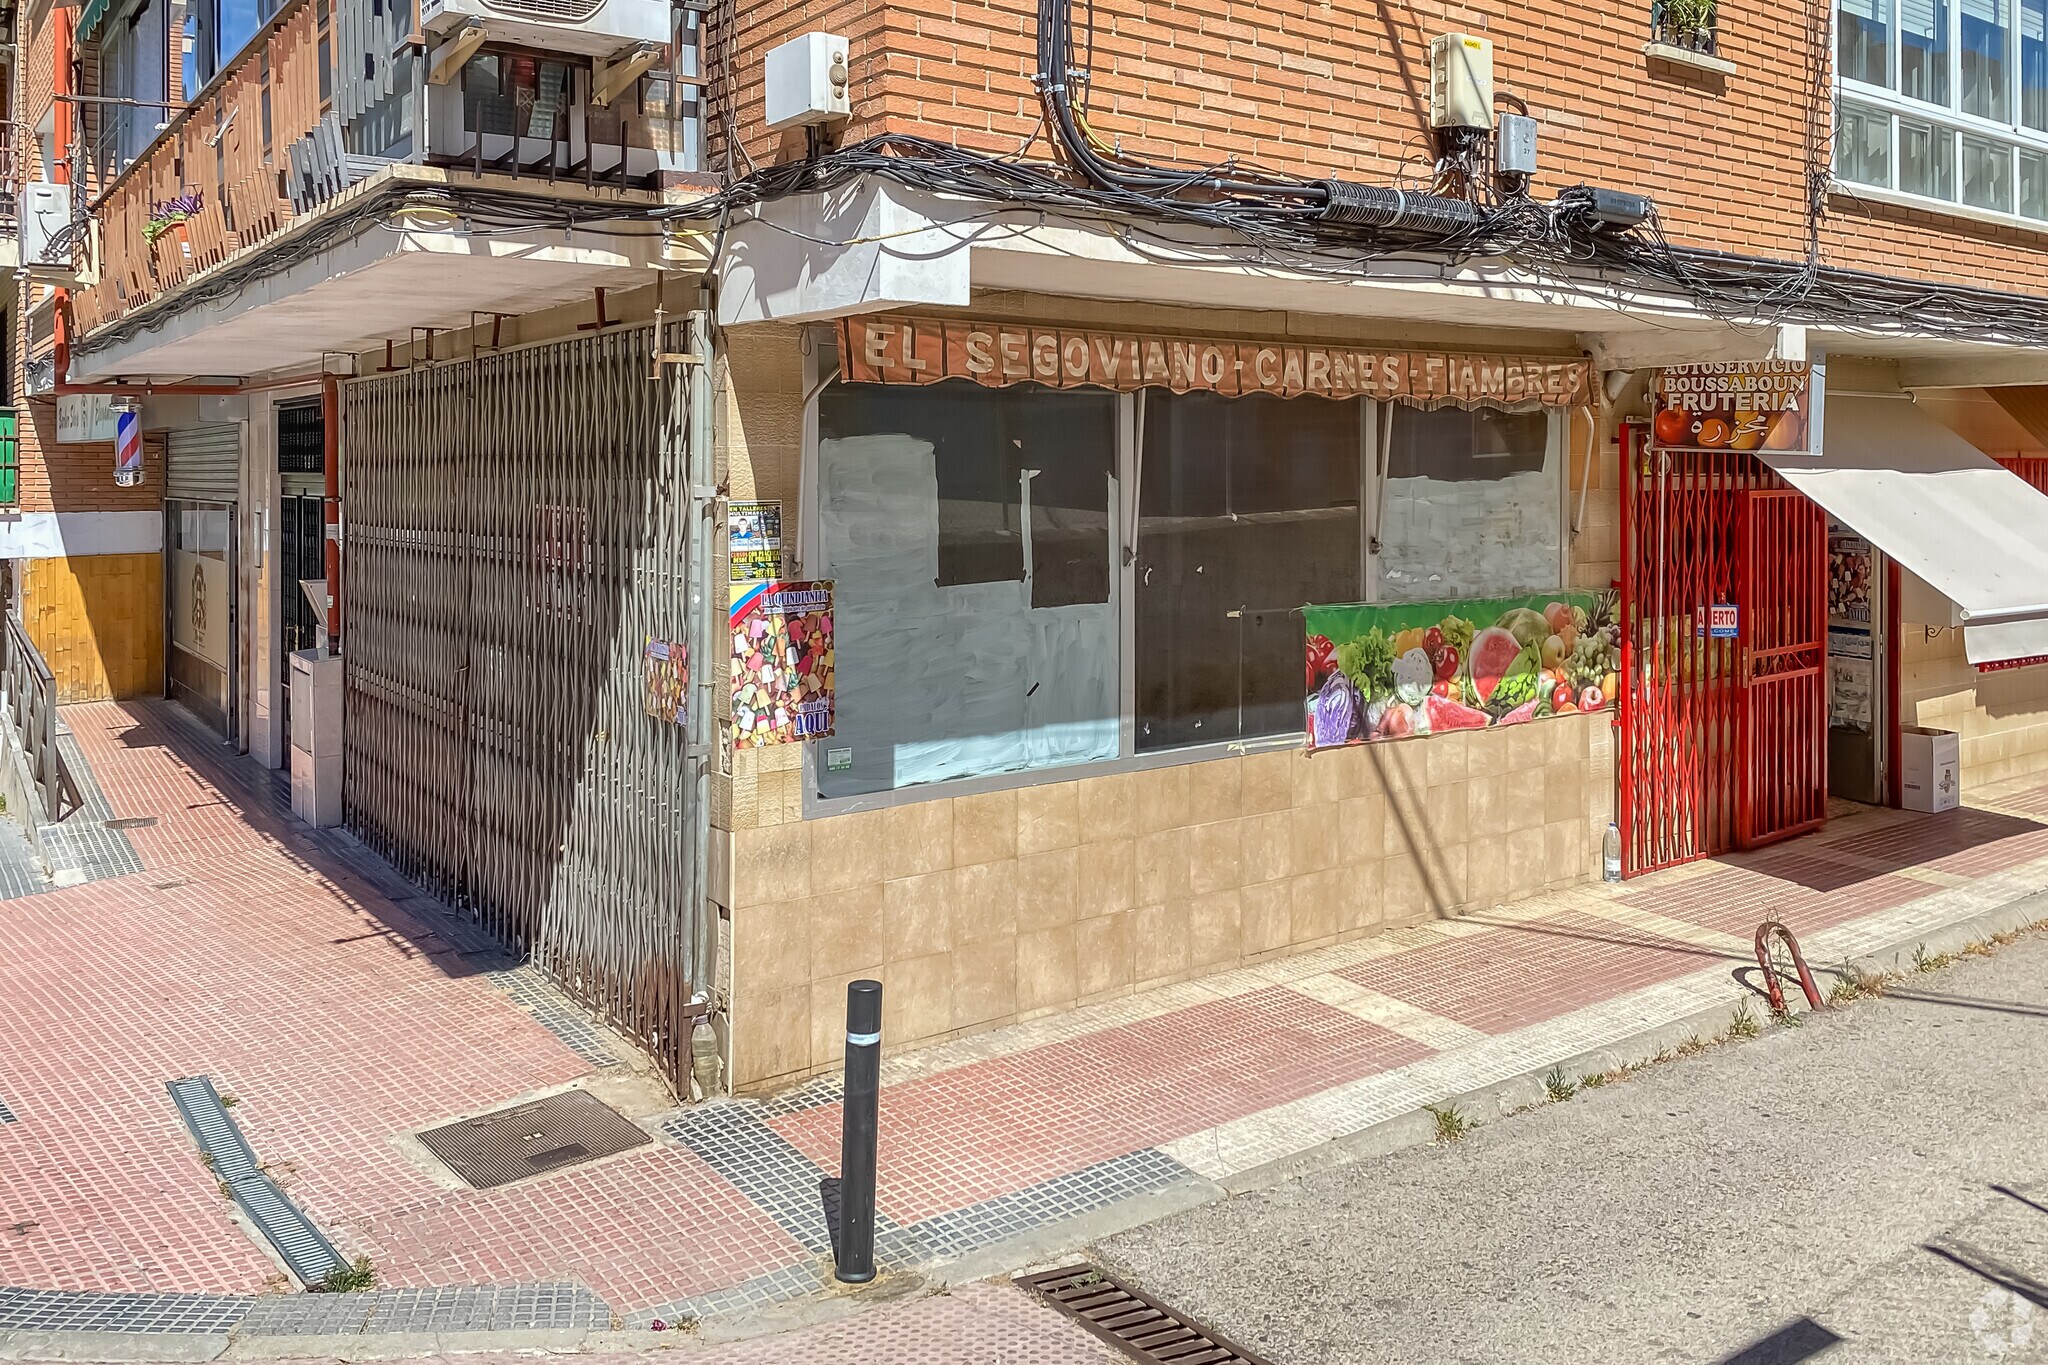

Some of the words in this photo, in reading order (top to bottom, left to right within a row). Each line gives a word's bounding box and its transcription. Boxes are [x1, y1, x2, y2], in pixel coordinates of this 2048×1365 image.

[866, 323, 926, 370] EL
[966, 331, 1225, 384] SEGOVIANO
[1255, 349, 1399, 390] CARNES
[1425, 358, 1583, 395] FIAMBRES
[1664, 361, 1806, 375] AUTOSERVICIO
[1664, 375, 1806, 392] BOUSSABOUN
[1667, 393, 1799, 411] FRUTERIA
[761, 594, 772, 606] LA
[1698, 610, 1736, 625] AERTO
